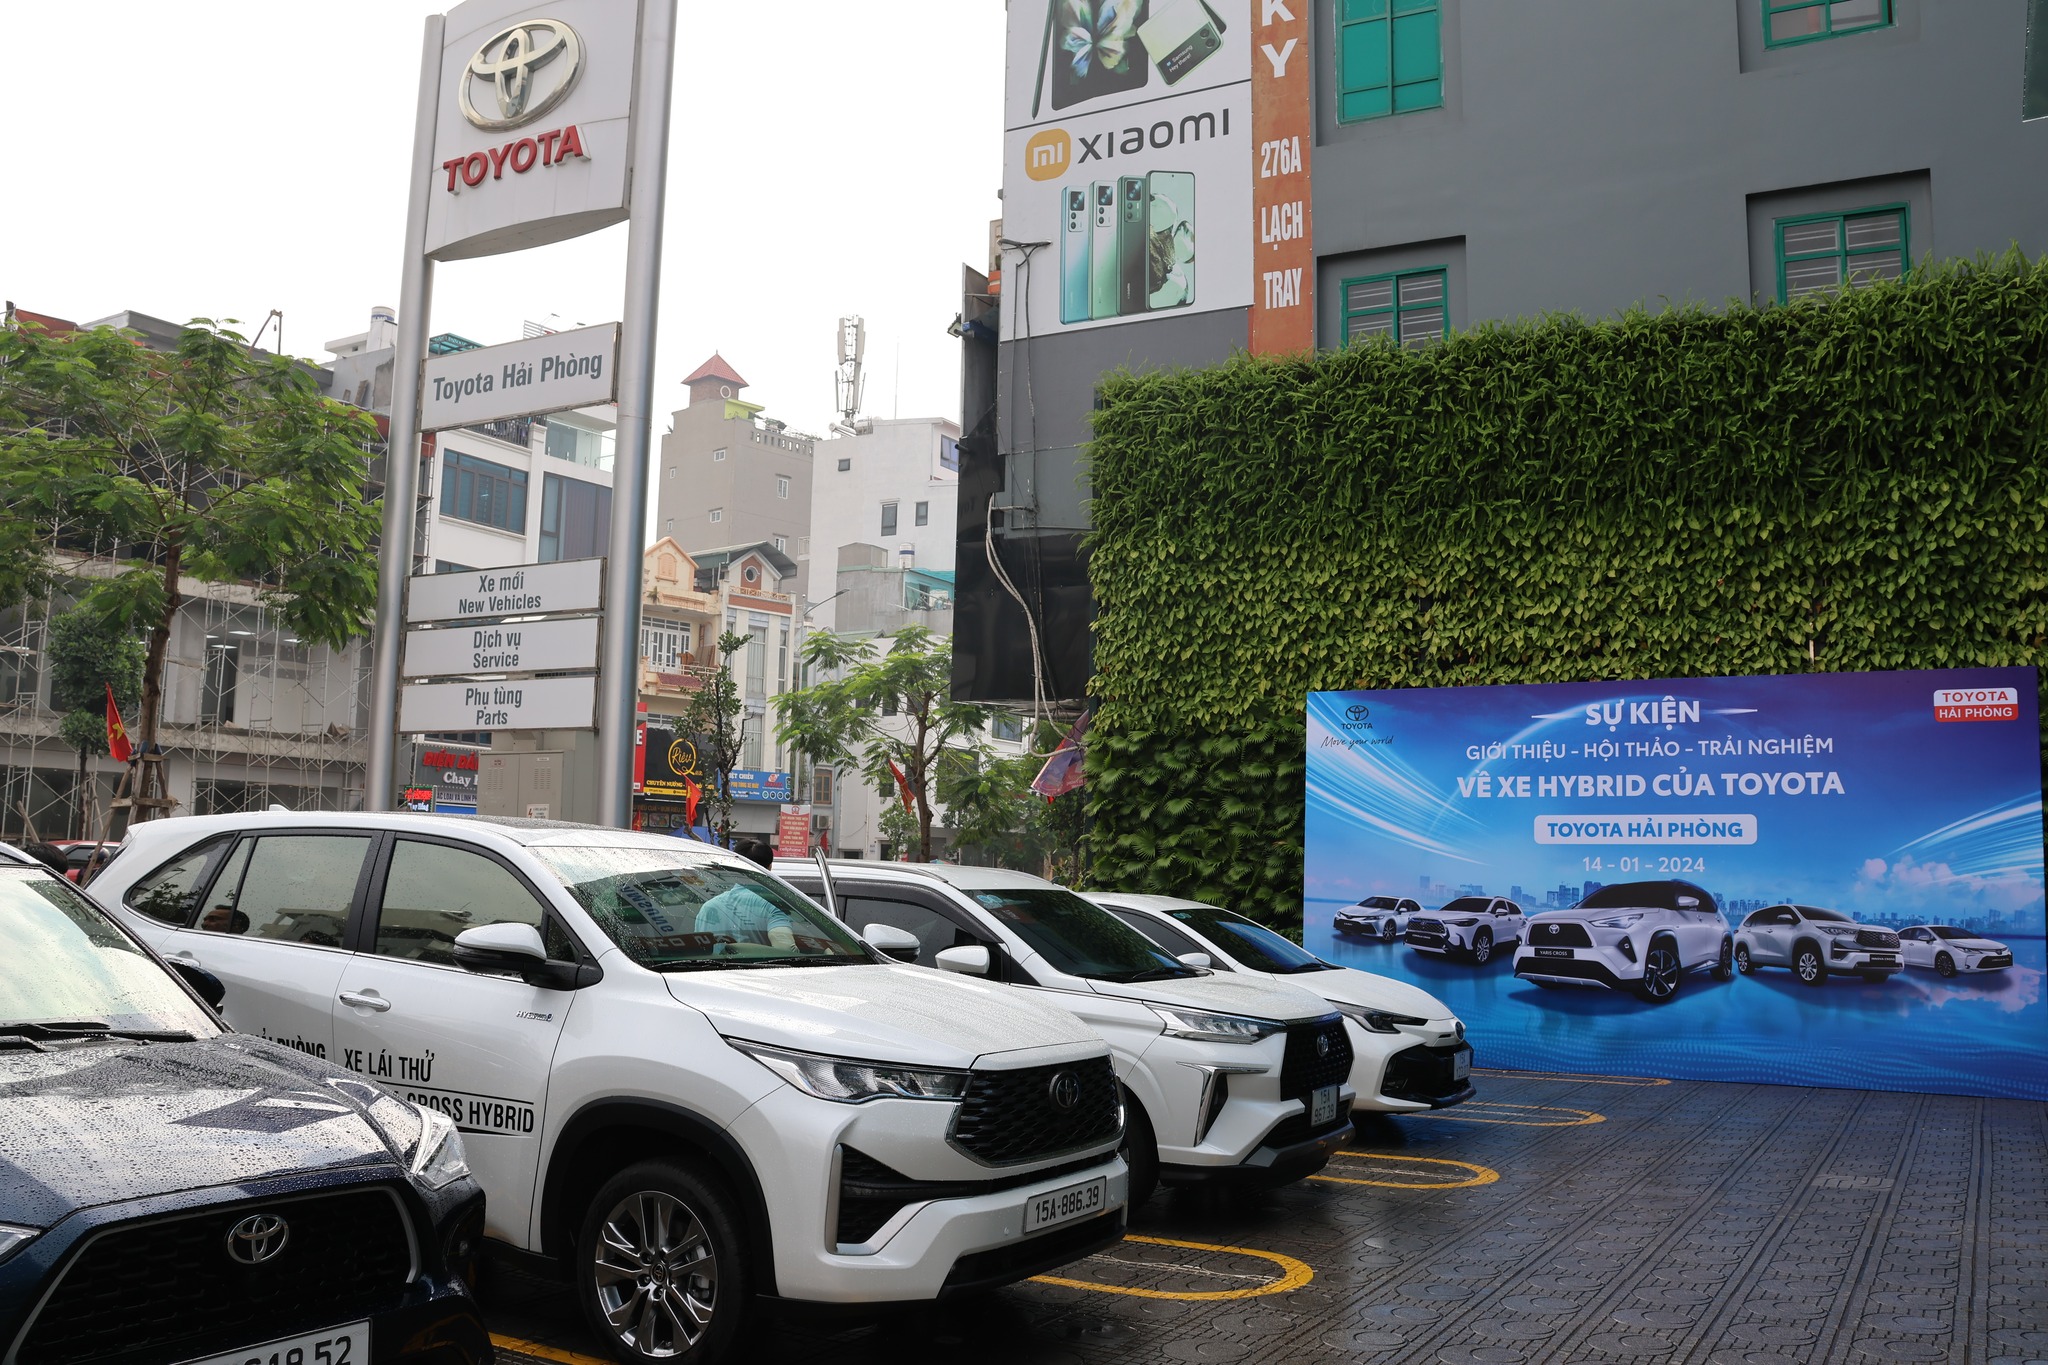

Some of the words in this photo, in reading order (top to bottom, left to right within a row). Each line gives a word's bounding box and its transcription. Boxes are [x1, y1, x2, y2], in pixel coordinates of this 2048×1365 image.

[443, 125, 588, 194] TOYOTA
[1260, 136, 1302, 178] 276A
[1261, 201, 1303, 250] LẠCH
[1263, 268, 1303, 310] TRAY
[433, 372, 494, 404] Toyota
[502, 362, 533, 389] Hải
[540, 353, 602, 380] Phòng
[478, 575, 495, 593] Xe
[499, 571, 525, 591] mới
[458, 598, 484, 615] New
[489, 593, 542, 612] Vehicles
[473, 630, 501, 652] Dịch
[506, 632, 522, 651] vụ
[473, 653, 520, 669] Service
[465, 687, 489, 710] Phụ
[493, 687, 523, 708] tùng
[1943, 691, 2009, 703] TOYOTA
[476, 708, 508, 726] Parts
[1585, 698, 1625, 733] SỰ
[1630, 695, 1700, 732] KIỆN
[1939, 706, 1962, 719] HẢI
[1965, 705, 2013, 718] PHÒNG
[1341, 722, 1373, 730] TOYOTA
[1320, 735, 1347, 749] Move
[1347, 739, 1368, 751] your
[1370, 735, 1395, 745] world
[1466, 740, 1507, 760] GIỚI
[1511, 740, 1566, 763] THIỆU
[1584, 738, 1619, 762] HỘI
[1624, 736, 1680, 758] THẢO
[1698, 734, 1742, 756] TRẢI
[1748, 734, 1833, 758] NGHIỆM
[1456, 769, 1491, 798] VỀ
[1497, 776, 1531, 798] XE
[1538, 774, 1646, 798] HYBRID
[1652, 765, 1716, 797] CỦA
[1720, 771, 1846, 796] TOYOTA
[1547, 822, 1624, 838] TOYOTA
[1627, 817, 1662, 838] HẢI
[1668, 818, 1743, 838] PHÒNG
[1582, 857, 1602, 872] 14
[1620, 856, 1640, 873] 01
[1658, 856, 1706, 873] 2024
[344, 1048, 363, 1072] XE
[368, 1048, 393, 1078] LÁI
[398, 1048, 435, 1083] THỬ
[469, 1101, 534, 1134] HYBRID
[1035, 1185, 1100, 1225] 15A-886.39
